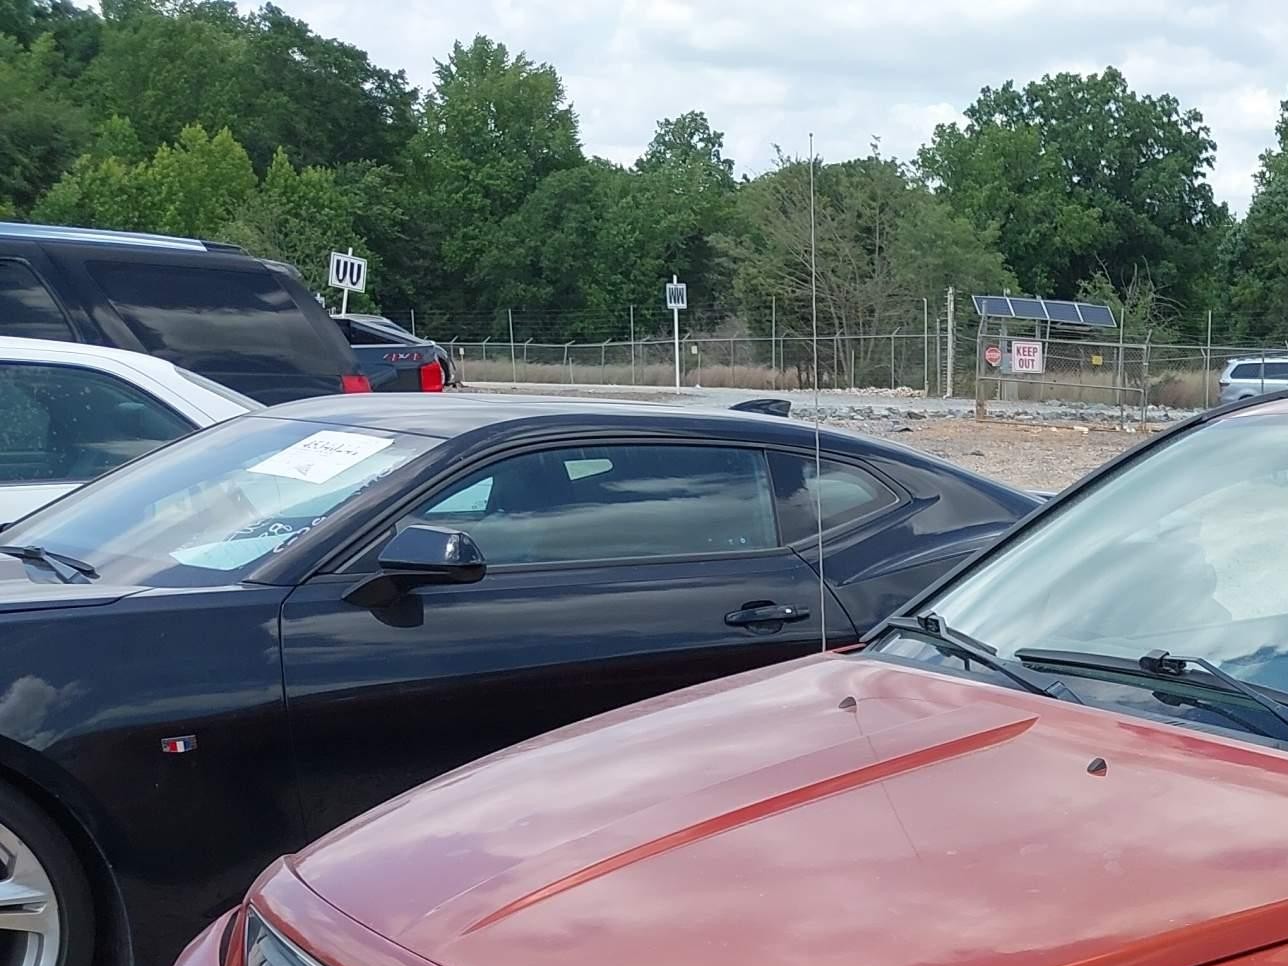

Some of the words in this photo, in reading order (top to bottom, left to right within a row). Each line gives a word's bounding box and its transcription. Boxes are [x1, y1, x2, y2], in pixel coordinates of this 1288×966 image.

[335, 258, 362, 286] UU
[1015, 346, 1038, 358] KEEP
[1018, 359, 1036, 369] OUT
